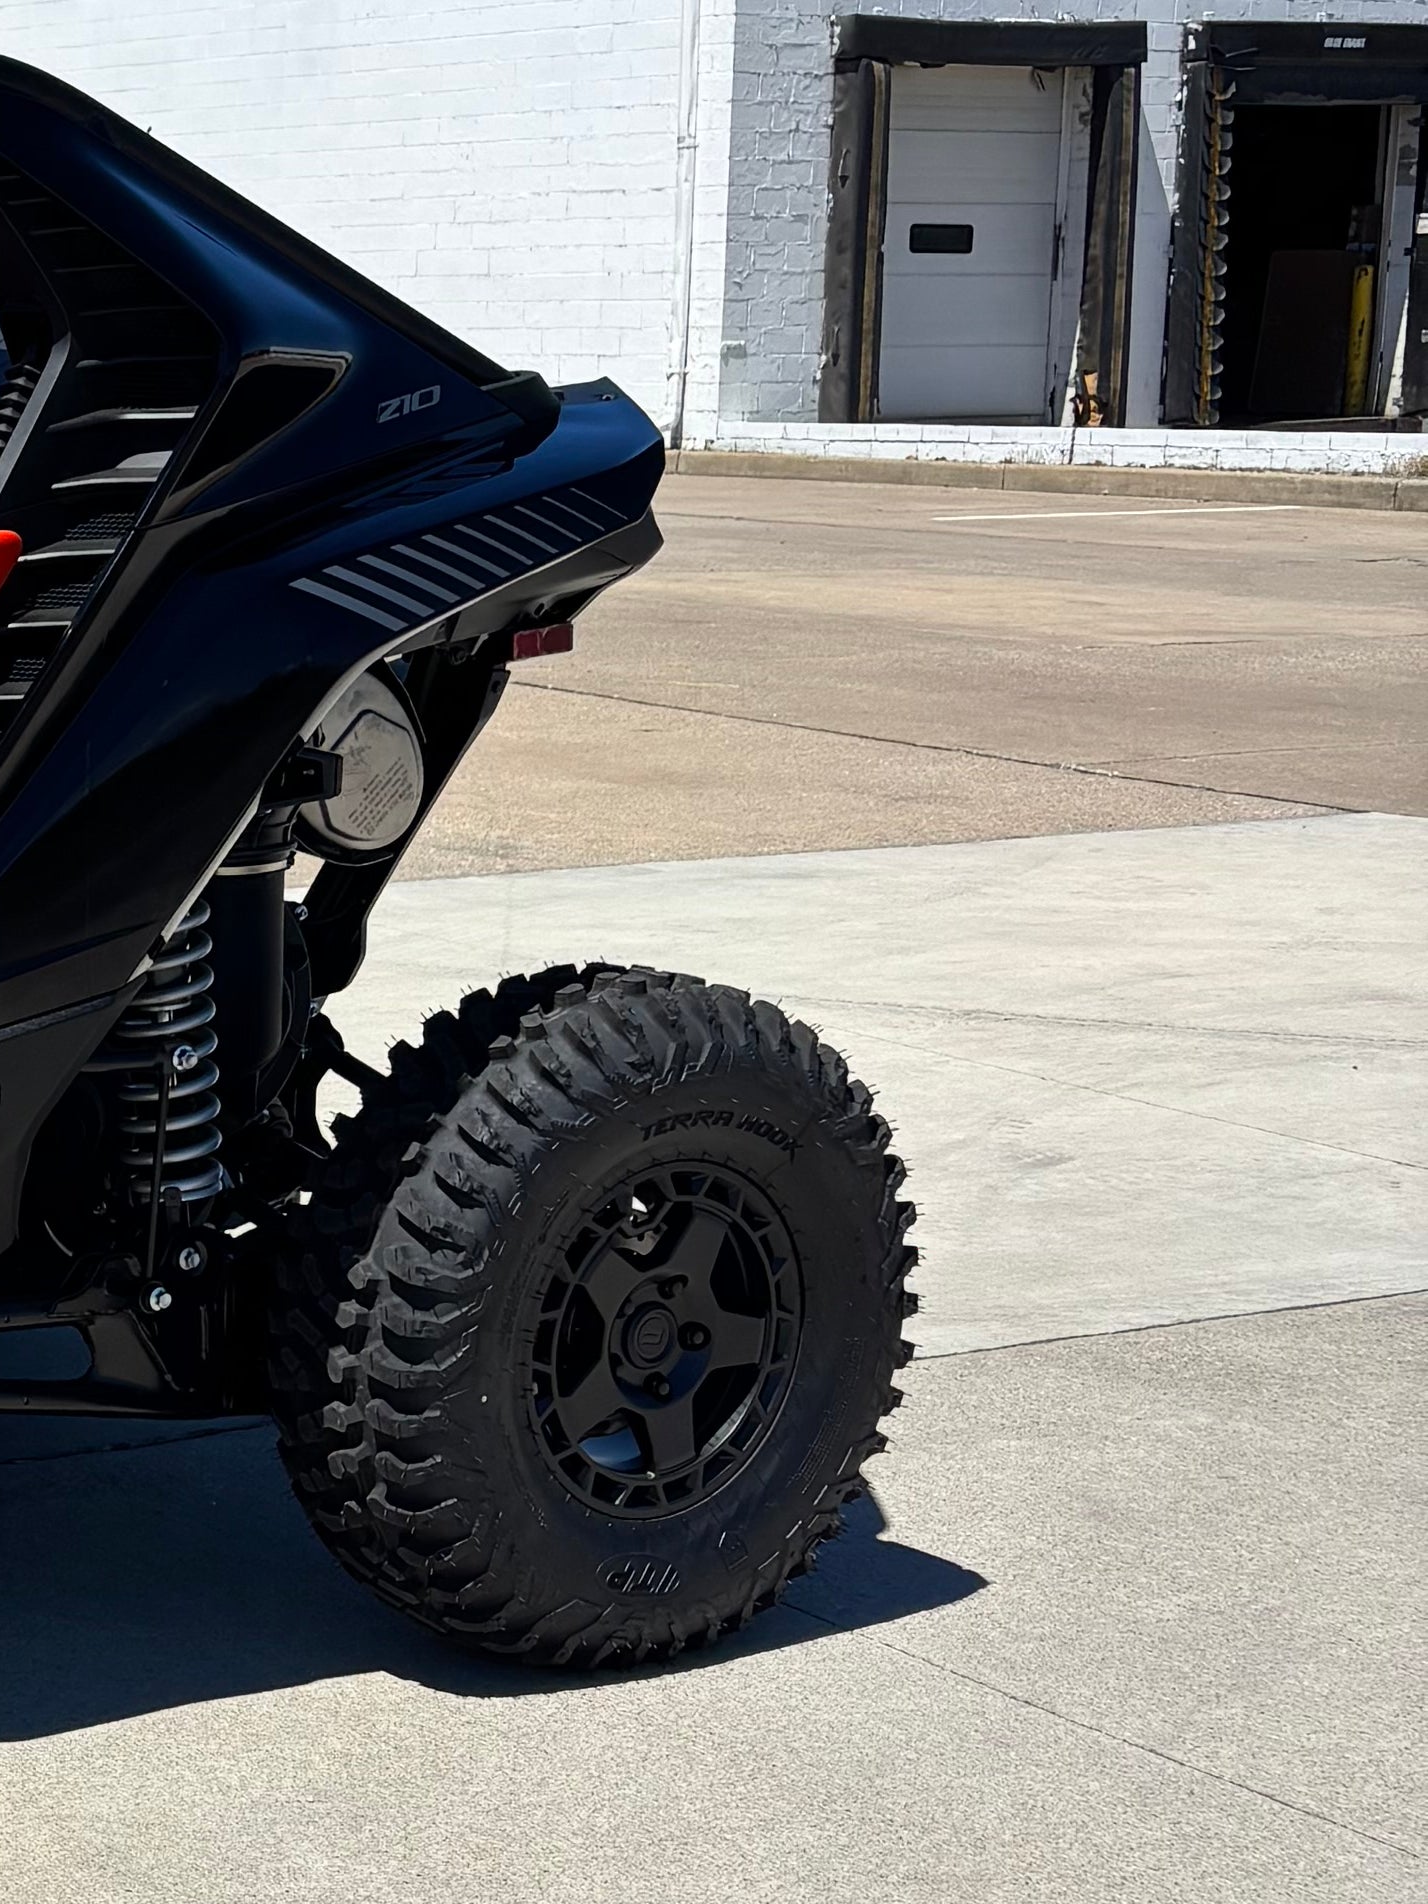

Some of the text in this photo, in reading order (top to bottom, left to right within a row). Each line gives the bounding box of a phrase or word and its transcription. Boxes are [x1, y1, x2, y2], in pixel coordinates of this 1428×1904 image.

[376, 384, 442, 425] Z10
[640, 1108, 805, 1167] TERRA HOOK
